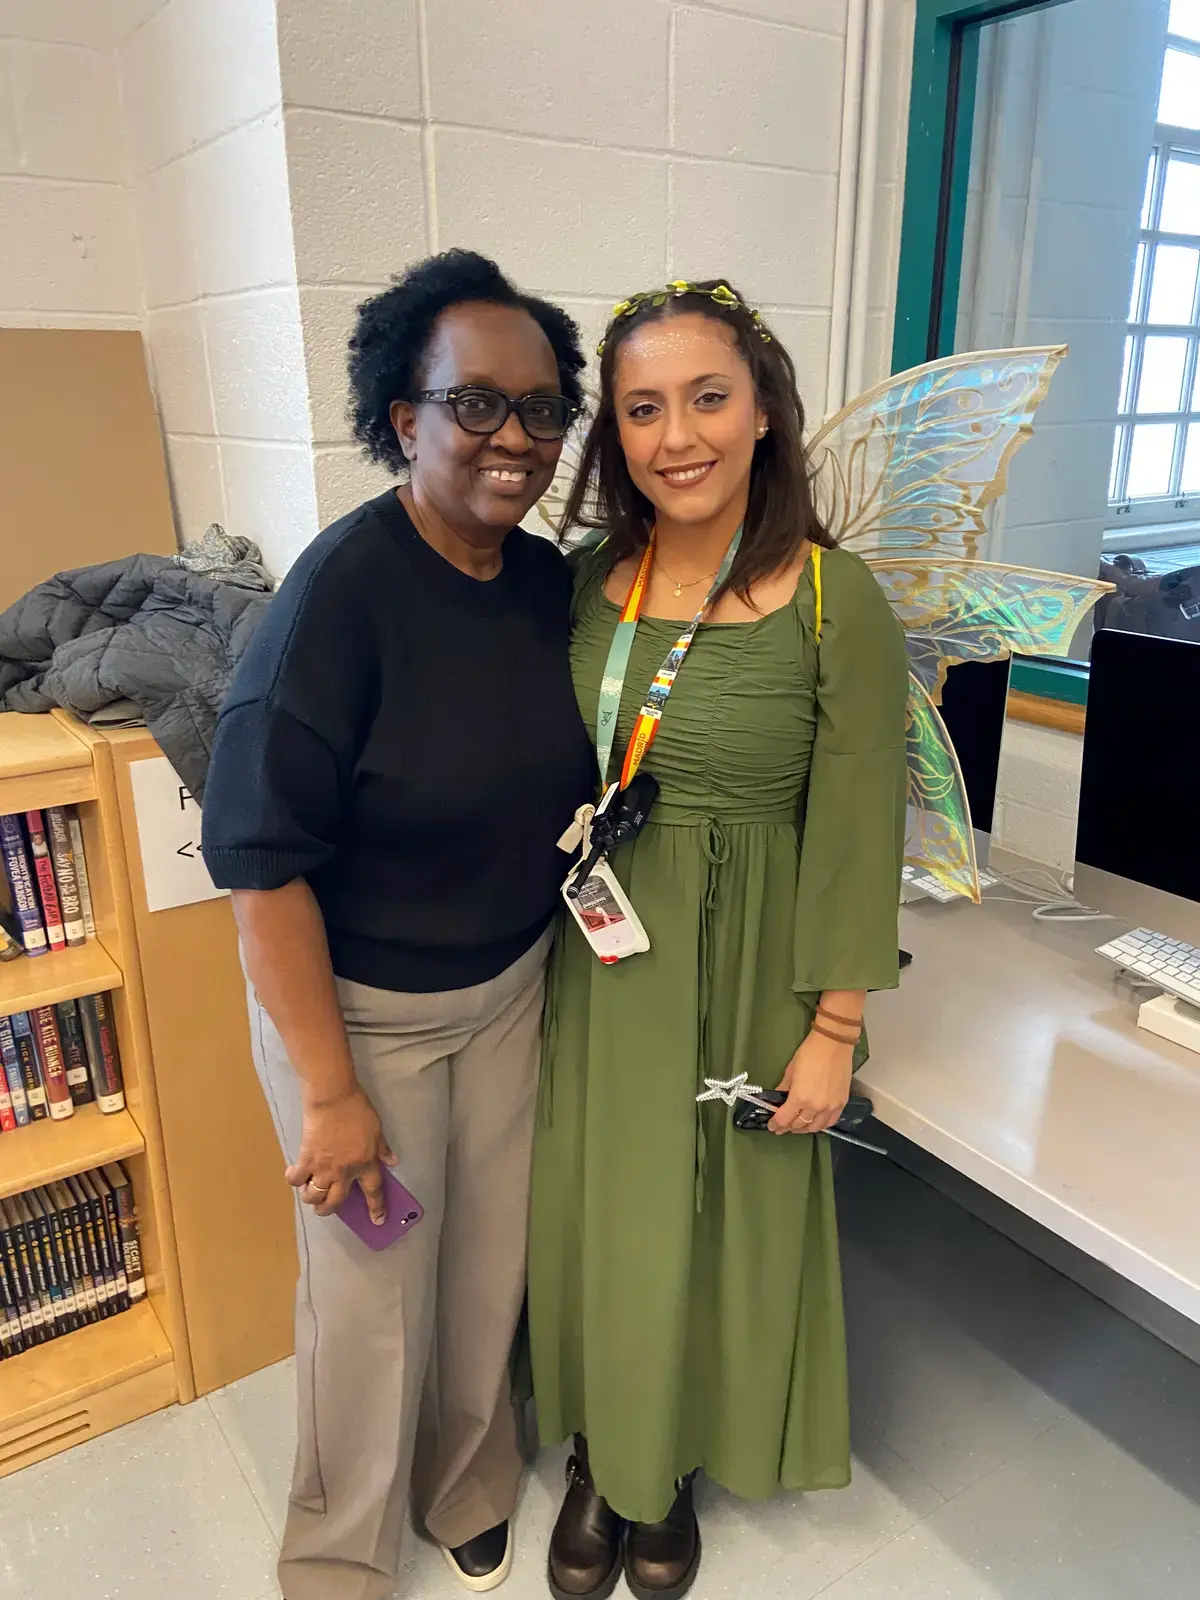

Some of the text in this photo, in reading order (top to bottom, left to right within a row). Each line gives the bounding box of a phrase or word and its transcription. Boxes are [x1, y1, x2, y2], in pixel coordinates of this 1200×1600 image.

[57, 868, 74, 884] NO
[62, 895, 80, 914] BRO
[0, 1029, 14, 1053] GIRL
[37, 1006, 63, 1078] THE KITE RUNNER
[129, 1239, 142, 1273] SECRET
